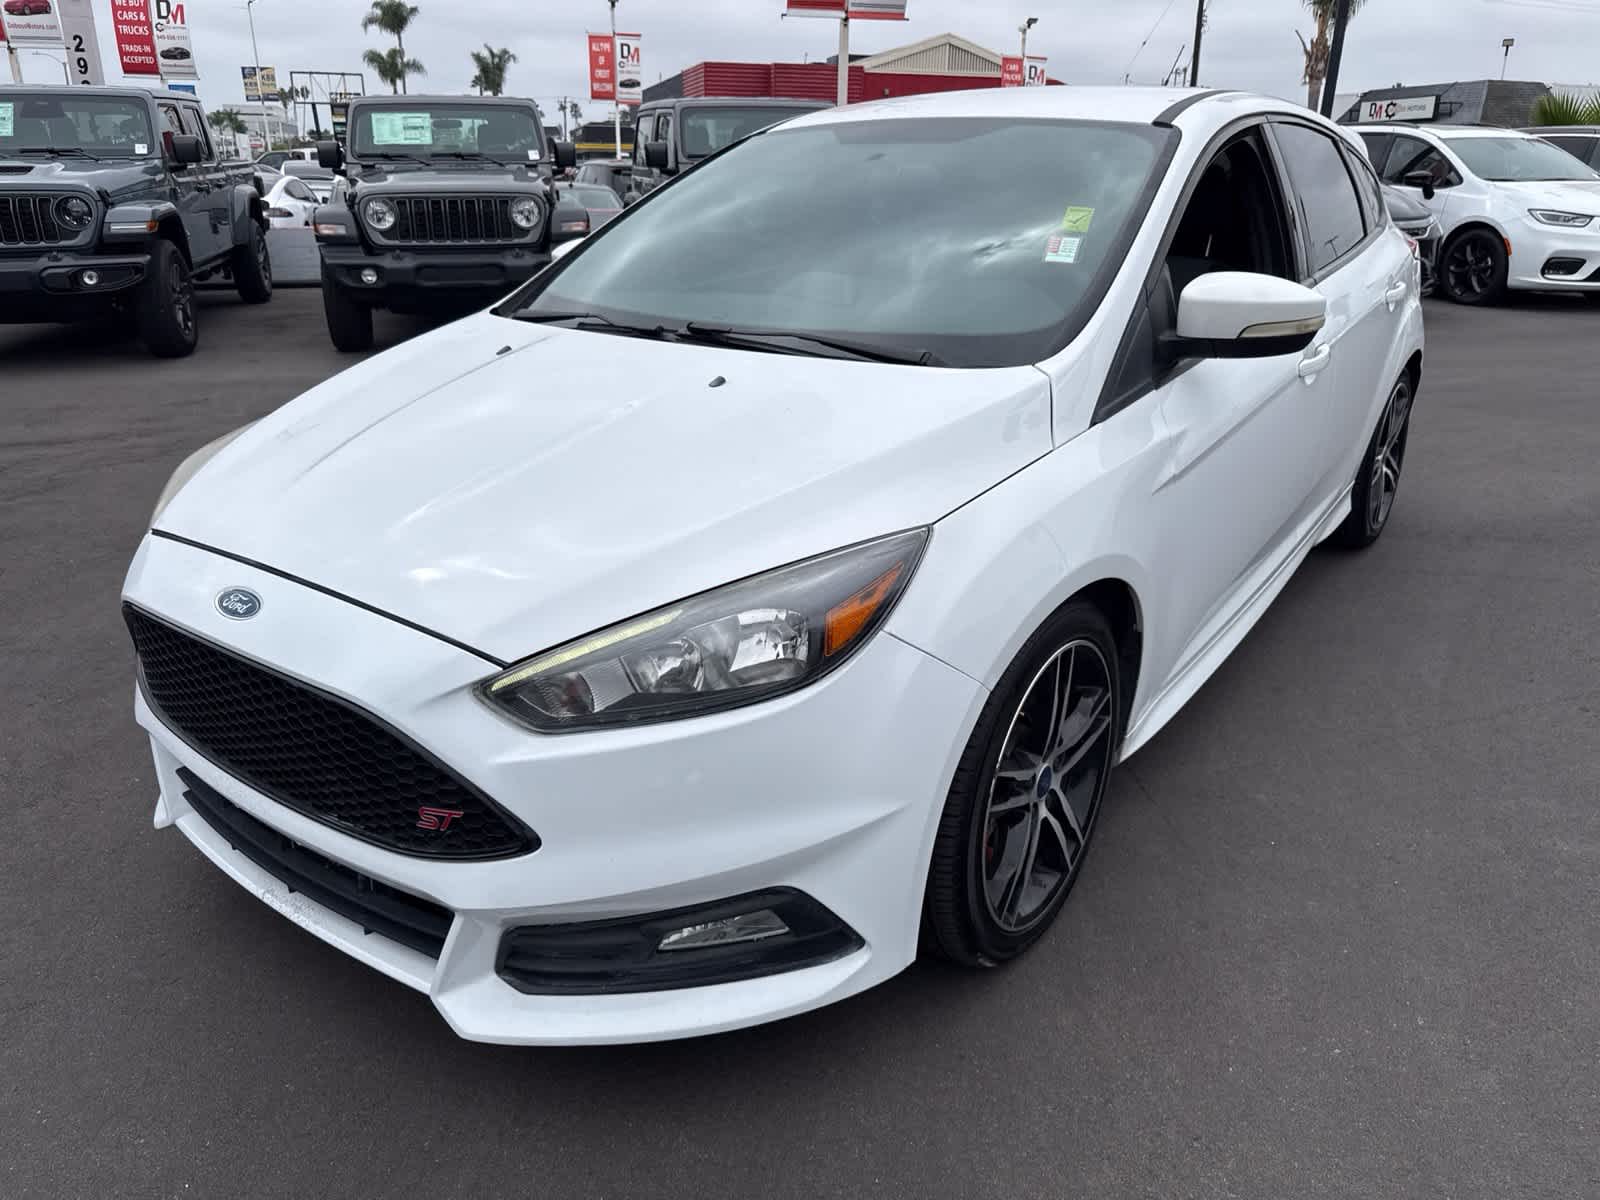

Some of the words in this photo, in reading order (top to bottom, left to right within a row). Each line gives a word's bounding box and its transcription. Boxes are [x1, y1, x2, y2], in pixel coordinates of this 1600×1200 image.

[117, 10, 138, 21] CARS
[139, 11, 146, 21] &
[117, 25, 150, 36] TRUCKS
[121, 44, 151, 53] TRADE-IN
[123, 55, 155, 65] ACCEPTED
[415, 806, 464, 831] ST
